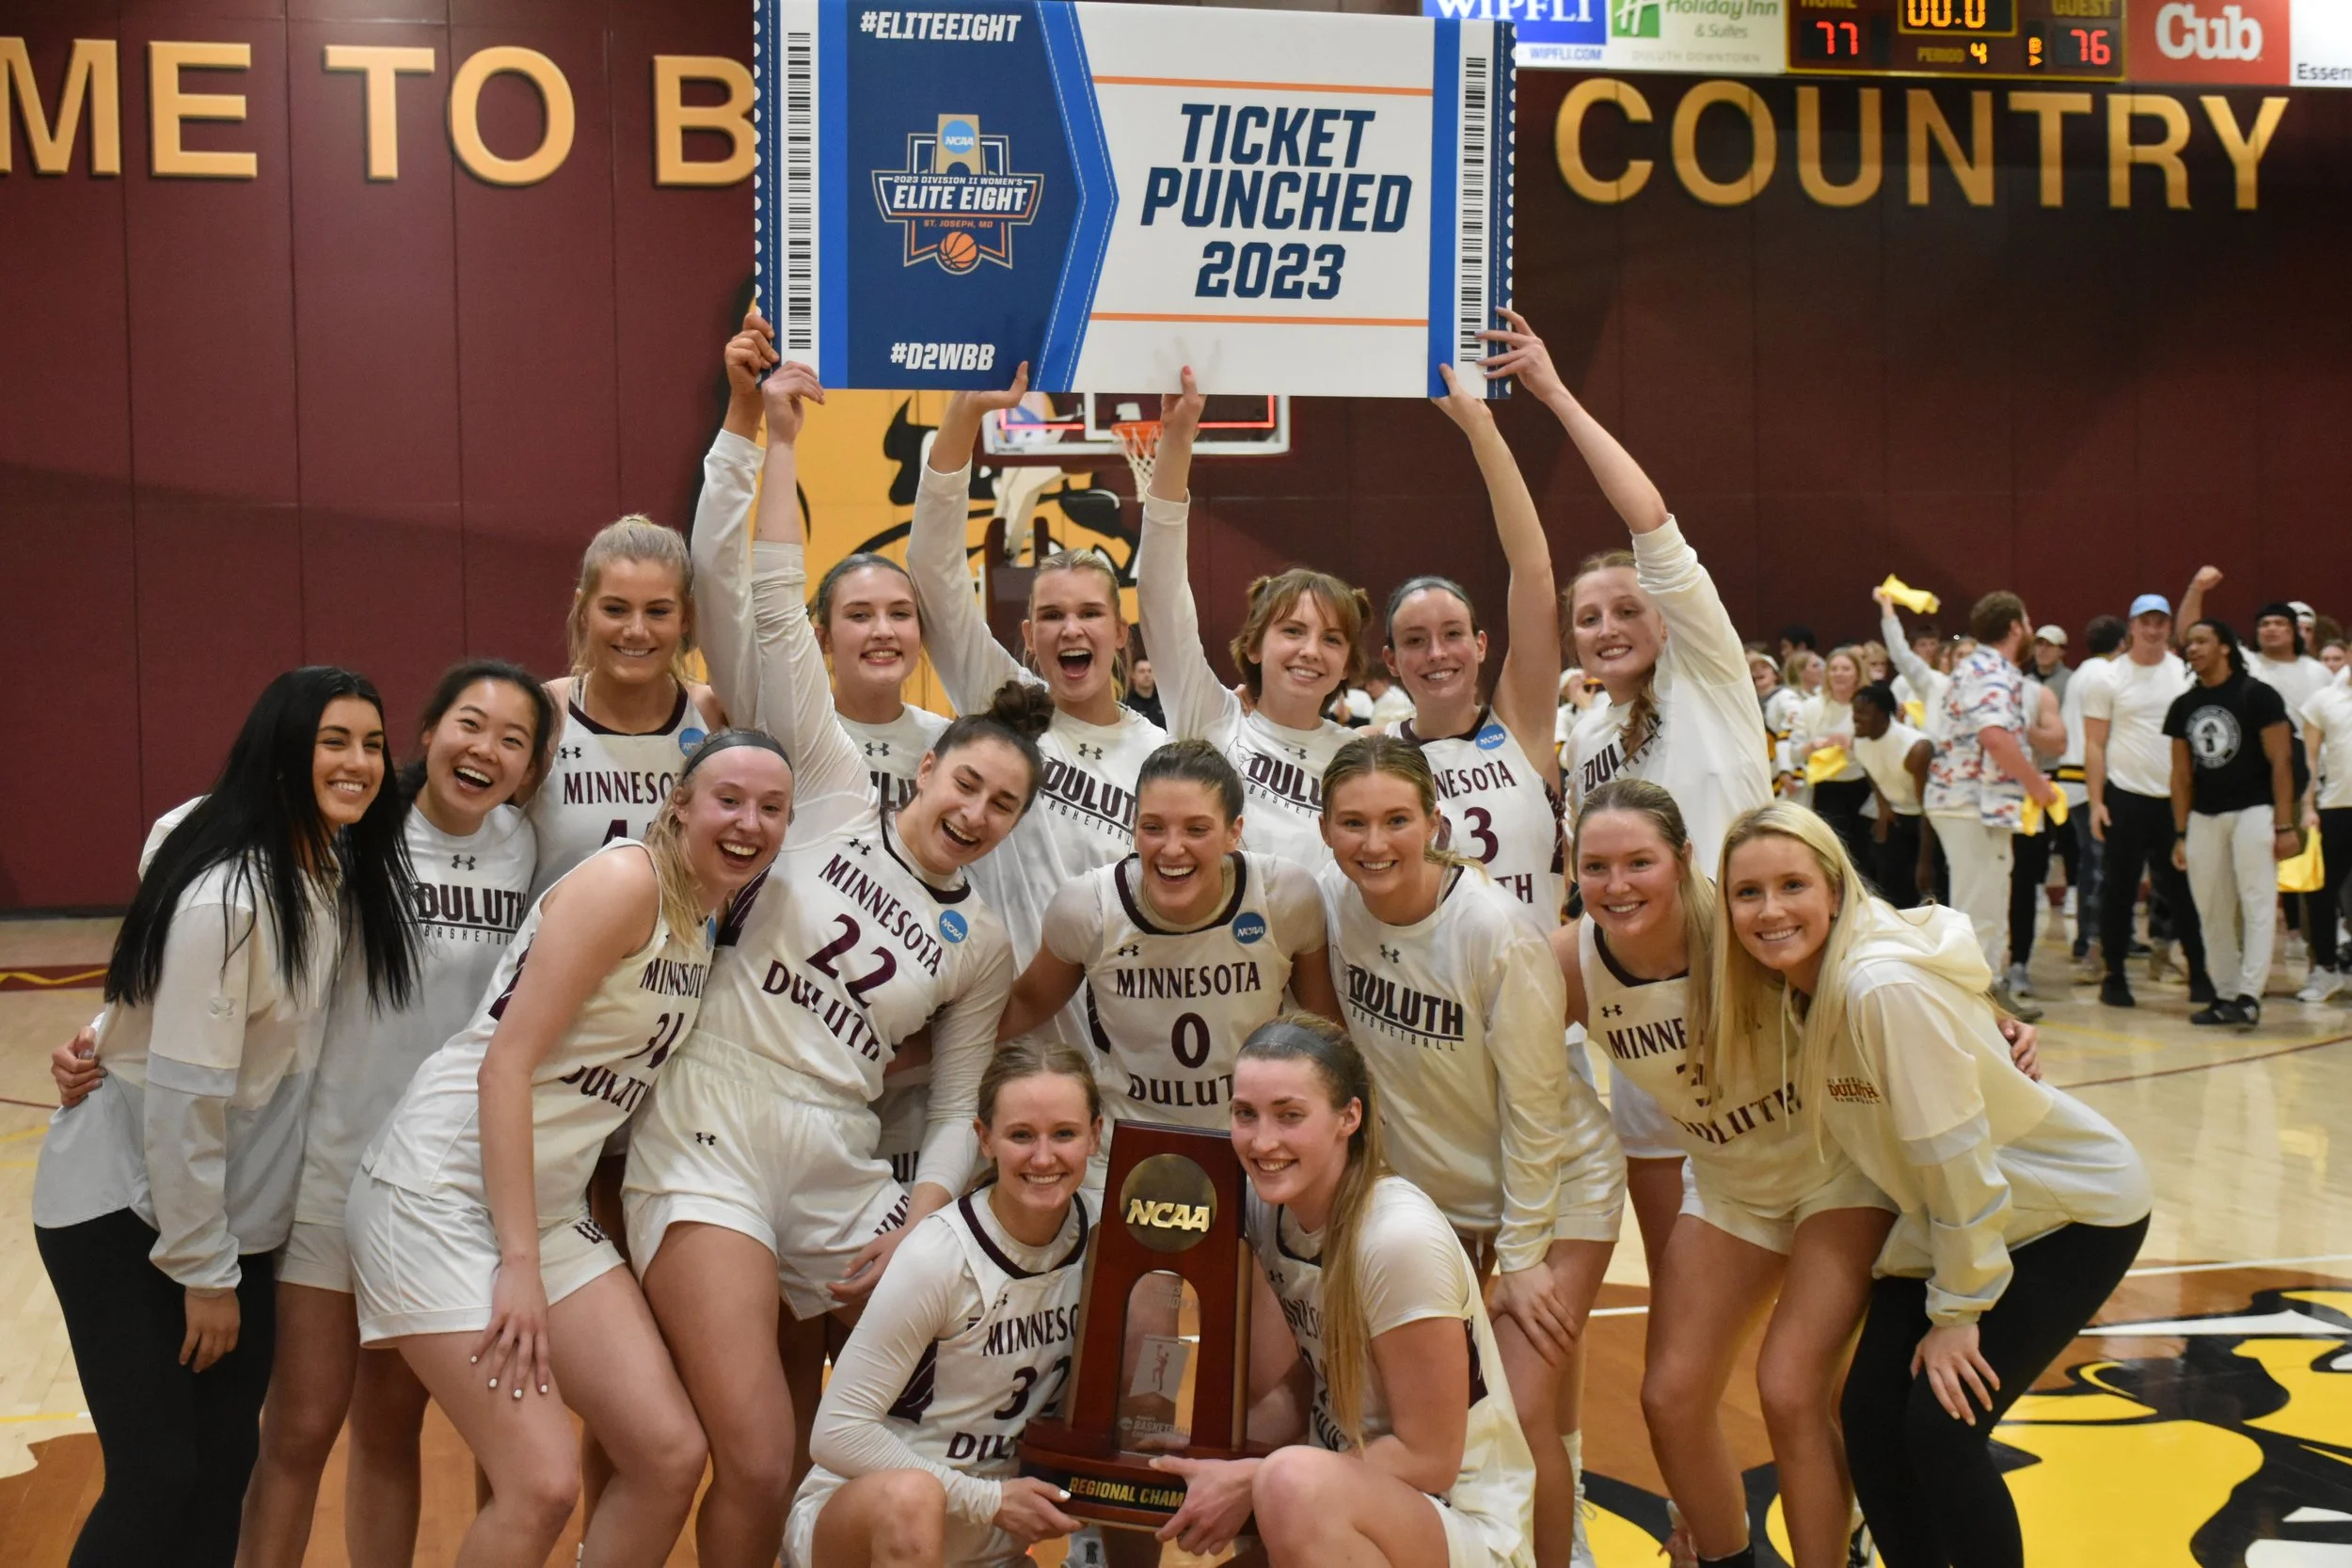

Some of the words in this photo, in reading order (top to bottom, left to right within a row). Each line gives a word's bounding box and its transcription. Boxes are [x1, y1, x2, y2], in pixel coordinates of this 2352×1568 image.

[1665, 0, 1742, 20] Holiday
[1746, 0, 1778, 15] Inn
[2052, 0, 2111, 16] GUEST
[860, 11, 1022, 41] #ELITEEIGHT
[1708, 24, 1748, 39] Suites
[1816, 21, 1858, 55] 77
[2154, 2, 2263, 61] Cub
[1530, 48, 1601, 61] WIPFLI.COM
[1970, 42, 1987, 64] 4
[2070, 29, 2111, 65] 76
[0, 37, 258, 179] ME
[325, 45, 577, 186] TO
[653, 55, 756, 187] B
[1555, 77, 2290, 211] COUNTRY
[1180, 103, 1375, 169] TICKET
[945, 135, 975, 148] NCAA
[894, 175, 919, 184] 2023
[920, 176, 967, 185] DIVISION
[968, 177, 977, 185] II
[980, 177, 1024, 186] WOMEN'S
[893, 185, 956, 211] ELITE
[959, 185, 1027, 212] EIGHT
[1140, 167, 1413, 234] PUNCHED
[923, 219, 937, 228] ST.
[939, 220, 976, 230] JOSEPH,
[978, 220, 993, 229] MO
[1194, 240, 1346, 301] 2023
[890, 341, 995, 372] #D2WBB
[1479, 733, 1504, 746] NCAA
[564, 770, 679, 805] MINNESO
[1041, 794, 1131, 847] ASKETBAL
[818, 853, 945, 978] MINNESOTA
[942, 918, 964, 941] NCAA
[1237, 924, 1265, 938] NCAA
[805, 912, 898, 1010] 22
[1116, 961, 1262, 1000] MINNESOTA
[1347, 963, 1464, 1037] DULUTH
[1171, 1011, 1211, 1069] 0
[1351, 1006, 1456, 1052] BASKETBALL
[1126, 1197, 1210, 1233] NCAA
[1069, 1476, 1136, 1503] REGIONAL
